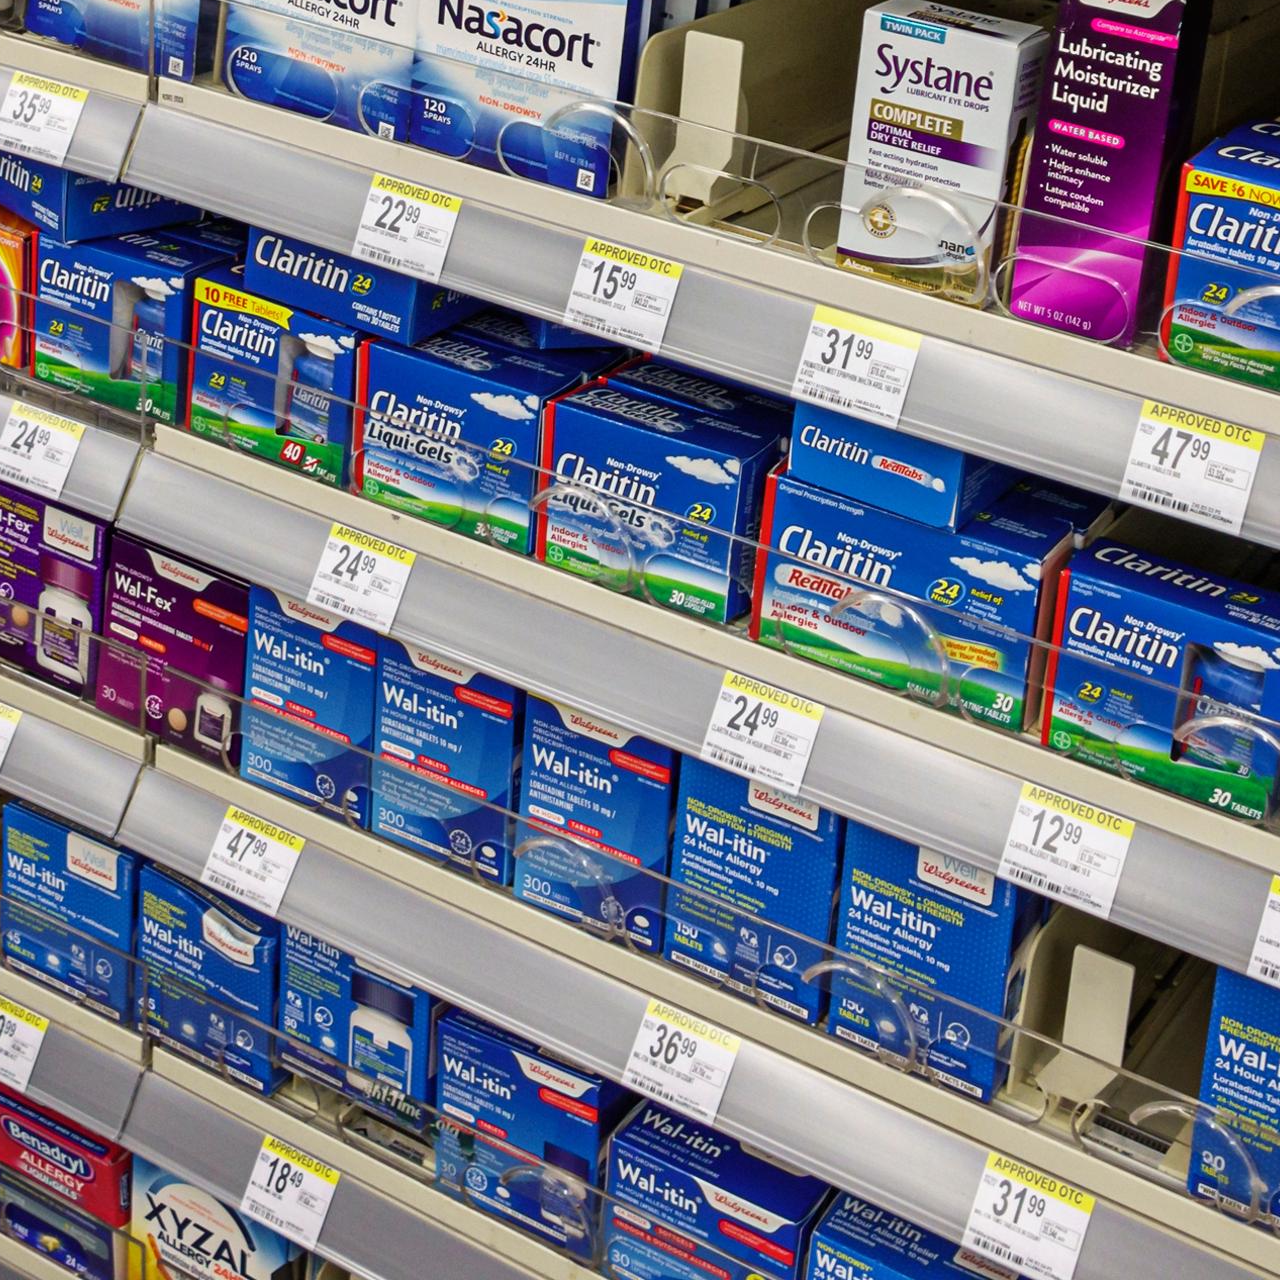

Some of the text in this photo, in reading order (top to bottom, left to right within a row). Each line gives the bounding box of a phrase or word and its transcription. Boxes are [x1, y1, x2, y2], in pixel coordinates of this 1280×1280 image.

[886, 22, 940, 40] TWIN PACK
[1058, 33, 1162, 81] Lubricating
[875, 43, 993, 101] Systane
[1054, 58, 1159, 99] Moisturizer
[423, 98, 446, 114] 120
[478, 94, 542, 119] NON-DROWSY
[907, 87, 989, 112] LUBRICANT EYE DROPS
[1052, 82, 1108, 113] Liquid
[423, 111, 451, 126] SPRAYS
[872, 122, 912, 139] OPTIMAL
[874, 104, 952, 135] COMPLETE
[871, 131, 941, 155] DRY EYE RELIEF
[1054, 123, 1120, 145] WATER BASED
[906, 156, 938, 170] hydration
[1052, 144, 1108, 166] Water soluble
[1048, 170, 1083, 187] intimacy
[1049, 159, 1111, 182] Helps enhance
[378, 175, 452, 207] APPROVED OTC
[1046, 183, 1103, 206] Latex condom
[1193, 176, 1228, 193] SAVE
[1231, 181, 1246, 198] $6
[1044, 195, 1089, 214] compatible
[254, 236, 350, 289] Claritin
[204, 286, 284, 320] 10 FREE Tablets!
[1018, 301, 1091, 330] NET WT 5 OZ (142 g)
[1150, 404, 1252, 444] APPROVED OTC
[800, 425, 872, 466] Claritin
[1070, 608, 1180, 667] Claritin
[383, 683, 459, 729] Wal-itin
[1209, 790, 1262, 820] 30 TABLETS
[850, 887, 936, 940] Wal-itin
[849, 909, 932, 951] 24 Hour Allergy
[145, 1191, 256, 1280] XYZAL
